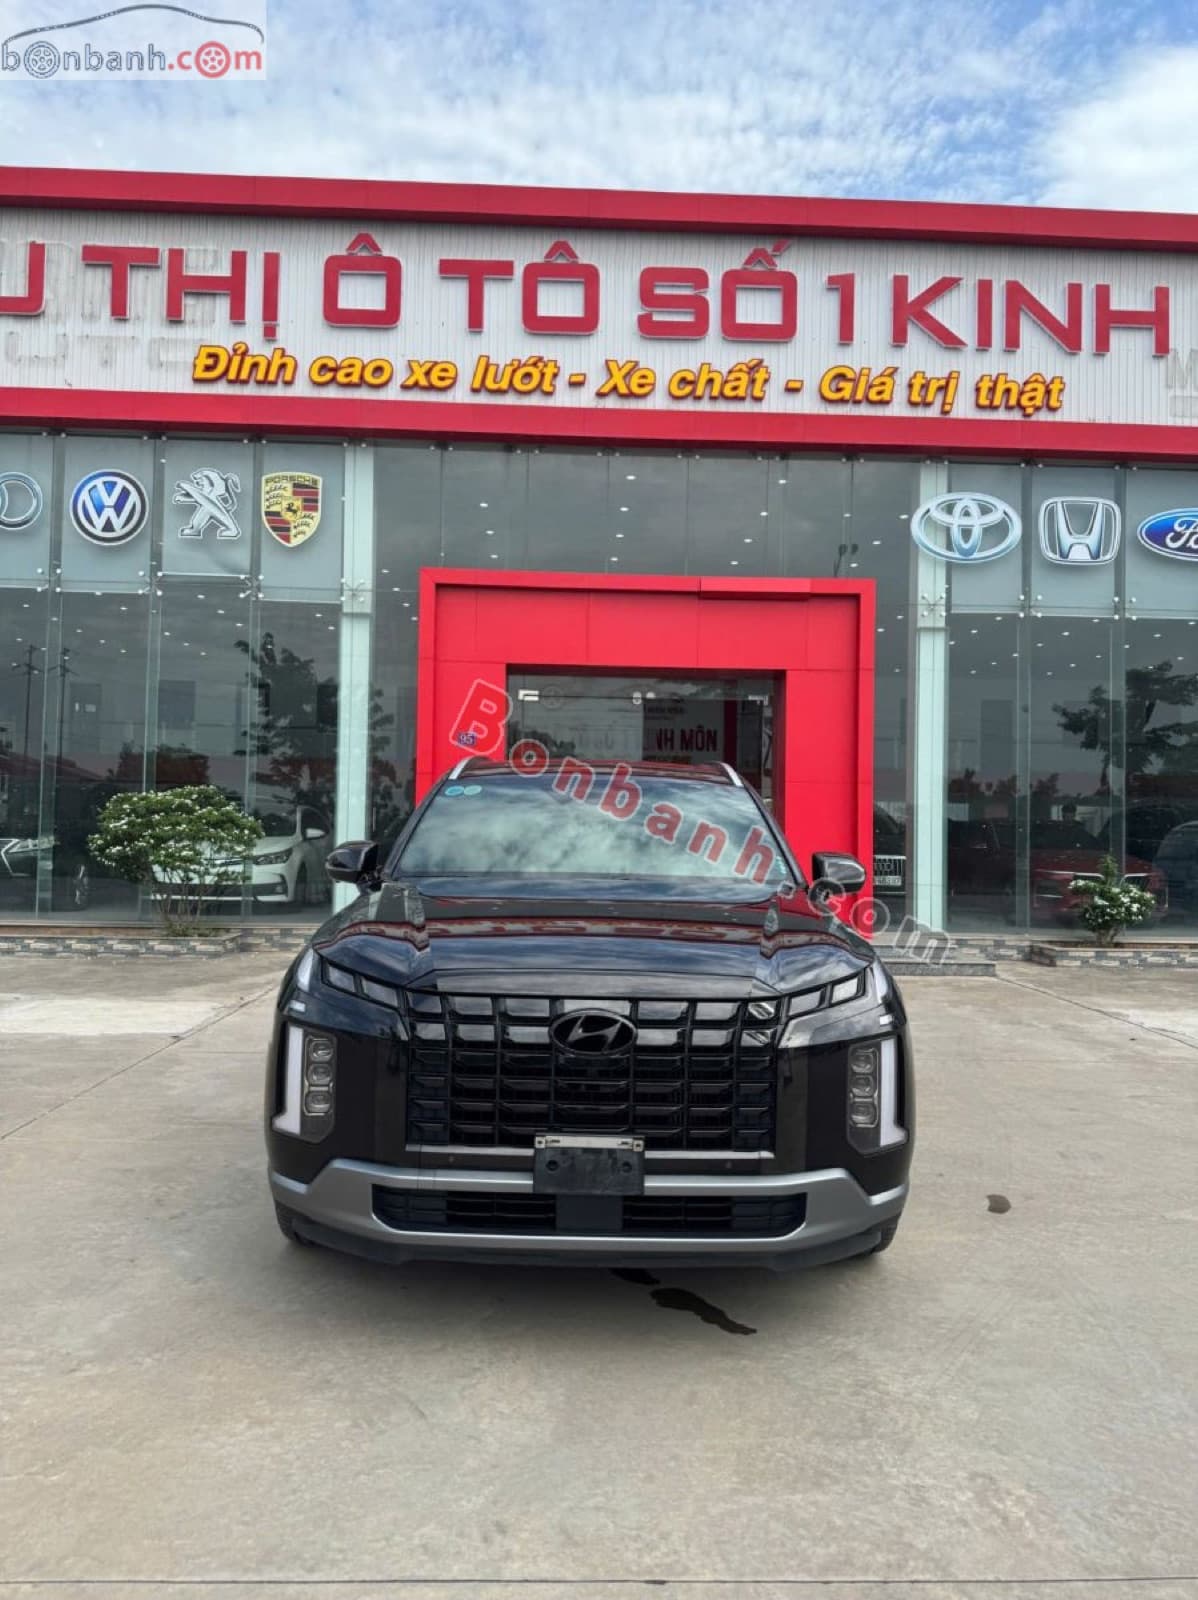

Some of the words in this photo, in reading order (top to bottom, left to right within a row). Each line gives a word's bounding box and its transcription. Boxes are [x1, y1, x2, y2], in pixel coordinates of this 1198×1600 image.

[82, 245, 279, 339] THỊ
[323, 232, 402, 327] Ô
[439, 240, 600, 333] TÔ
[637, 239, 798, 341] SỐ
[826, 273, 856, 343] 1
[892, 274, 1170, 356] KINH
[192, 341, 296, 384] Đỉnh
[308, 355, 394, 387] cao
[403, 358, 458, 390] xe
[471, 354, 559, 394] lướt
[597, 359, 657, 397] Xe
[668, 358, 769, 400] chất
[819, 365, 896, 403] Giá
[909, 369, 960, 413] trị
[976, 372, 1065, 416] thật
